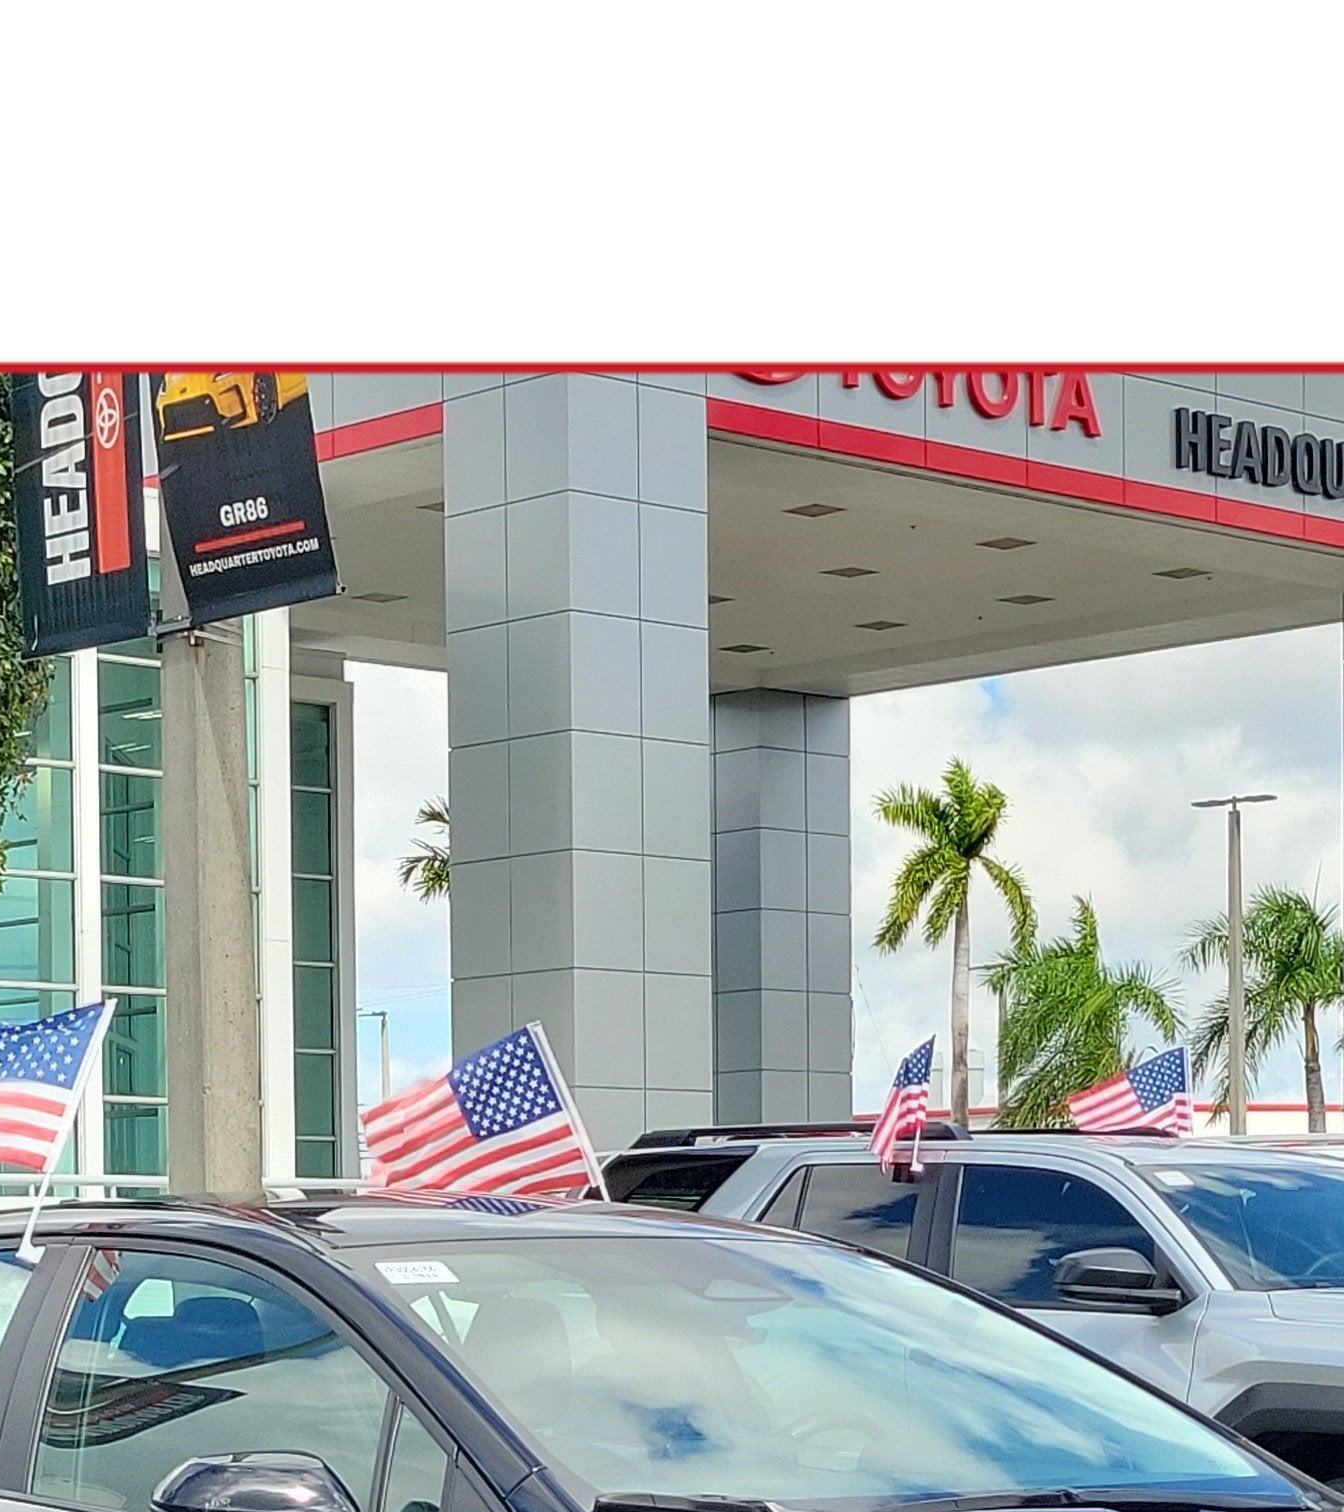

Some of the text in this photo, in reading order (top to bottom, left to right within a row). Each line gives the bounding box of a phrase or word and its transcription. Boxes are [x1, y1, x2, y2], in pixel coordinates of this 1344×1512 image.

[842, 372, 1103, 438] YOTA
[219, 496, 270, 527] GR86
[189, 537, 320, 577] HEADQUARTERTOYOTA.COM
